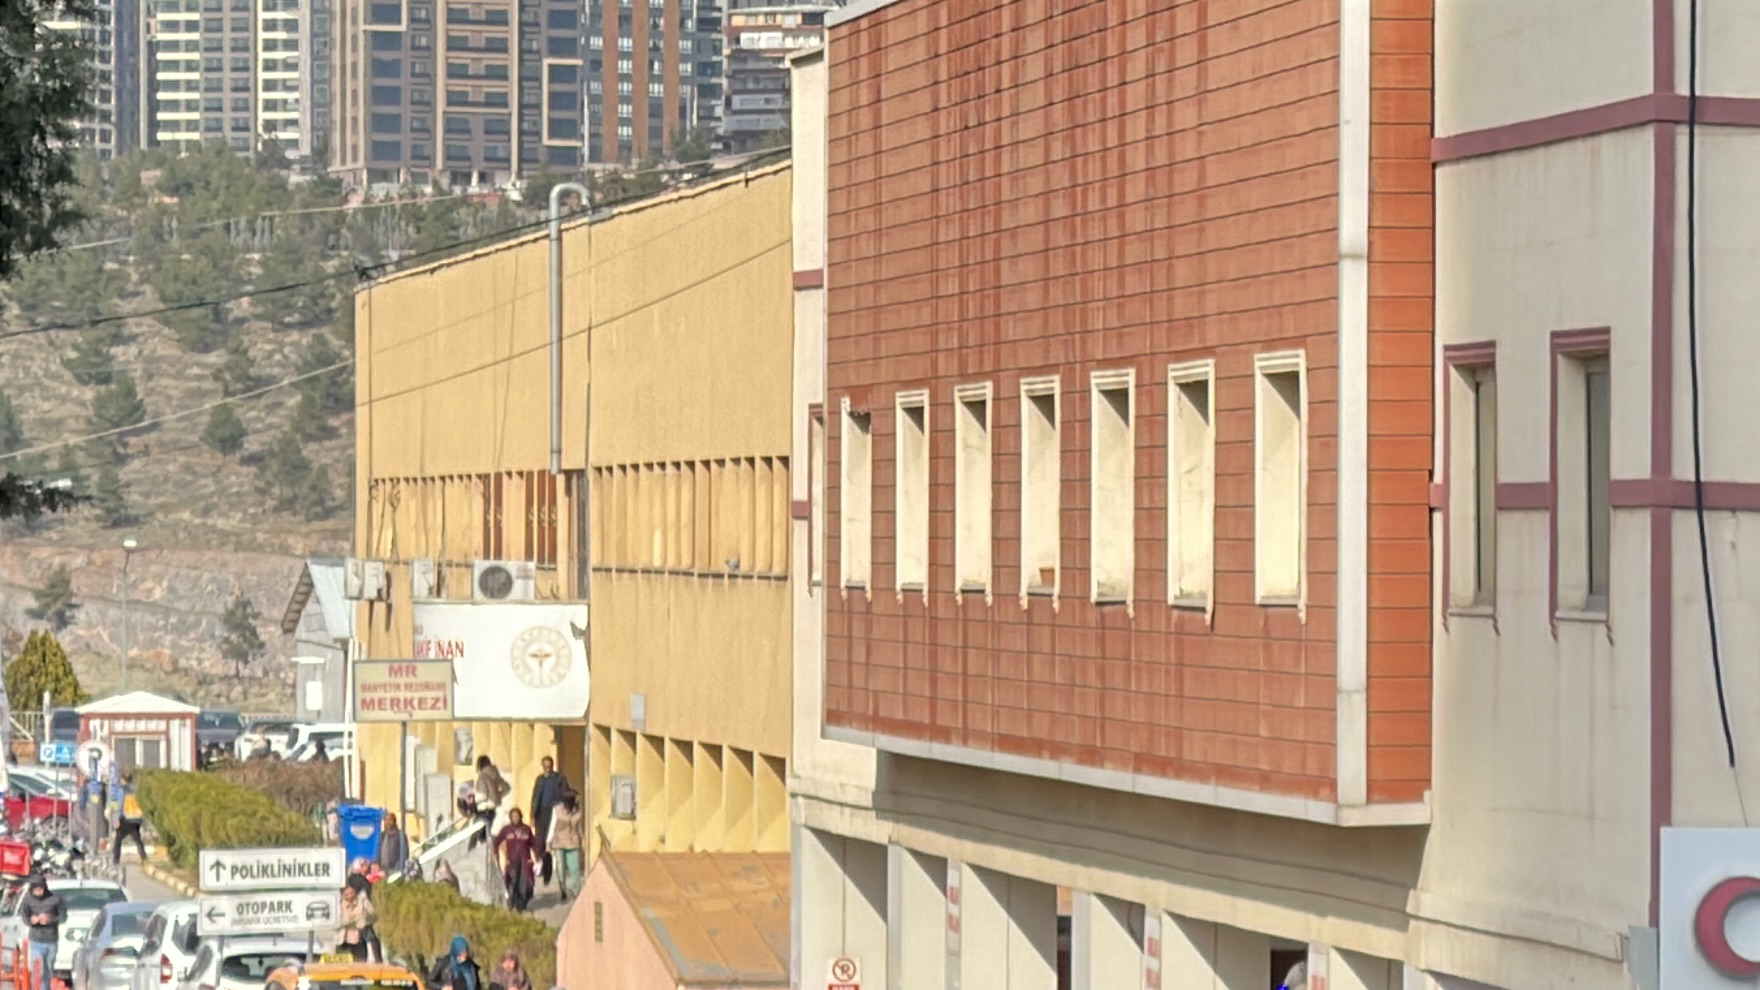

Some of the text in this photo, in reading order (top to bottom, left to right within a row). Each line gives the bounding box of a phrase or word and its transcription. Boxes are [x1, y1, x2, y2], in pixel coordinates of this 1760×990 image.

[388, 664, 417, 678] MR
[361, 694, 447, 711] MERKEZİ
[230, 858, 331, 881] POLİKLİNİKLER
[236, 900, 293, 915] OTOPARK
